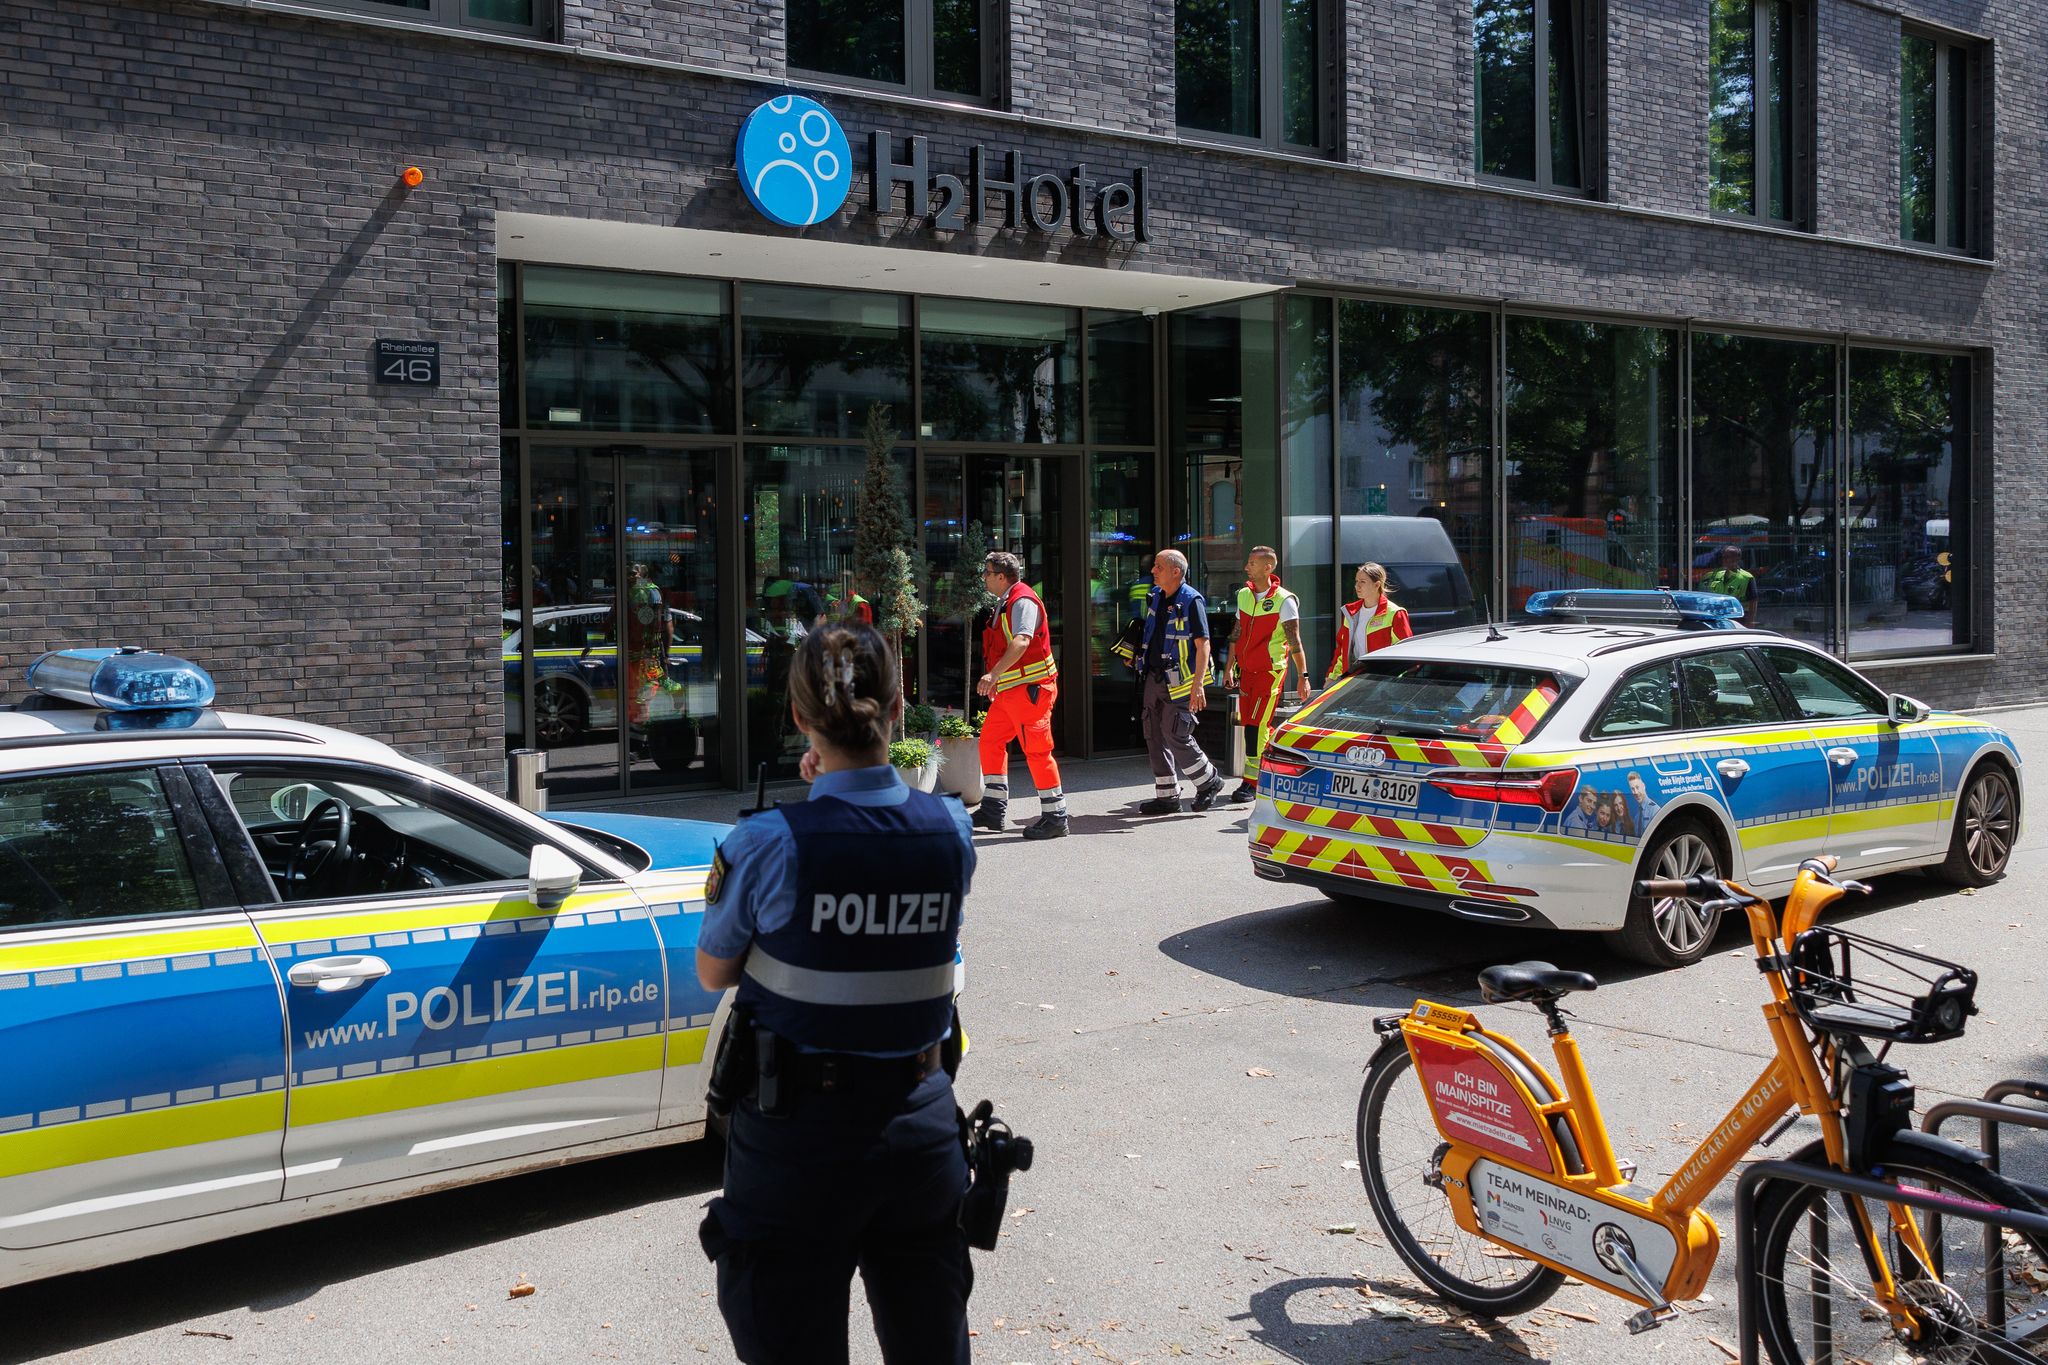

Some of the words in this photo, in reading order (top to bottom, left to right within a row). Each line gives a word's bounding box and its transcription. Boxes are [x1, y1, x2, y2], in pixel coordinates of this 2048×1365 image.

[381, 342, 435, 353] Rheinallee
[384, 359, 431, 382] 46
[1276, 777, 1320, 797] POLIZEI
[1332, 774, 1358, 795] RPL
[1361, 778, 1370, 797] 4
[1380, 781, 1417, 803] 8109
[1835, 763, 1940, 793] www.POLIZEI.rlp.de
[811, 892, 951, 935] POLIZEI
[304, 970, 659, 1049] www.POLIZEI.rlp.de
[1430, 1009, 1463, 1023] 555551
[1454, 1071, 1474, 1089] ICH
[1477, 1079, 1498, 1097] BIN
[1435, 1080, 1512, 1118] (MAIN)SPITZE
[1664, 1117, 1741, 1205] MAINZIGARTIG
[1741, 1075, 1783, 1119] MOBIL
[1487, 1172, 1522, 1196] TEAM
[1525, 1187, 1591, 1223] MEINRAD:
[1549, 1215, 1572, 1231] LNVG
